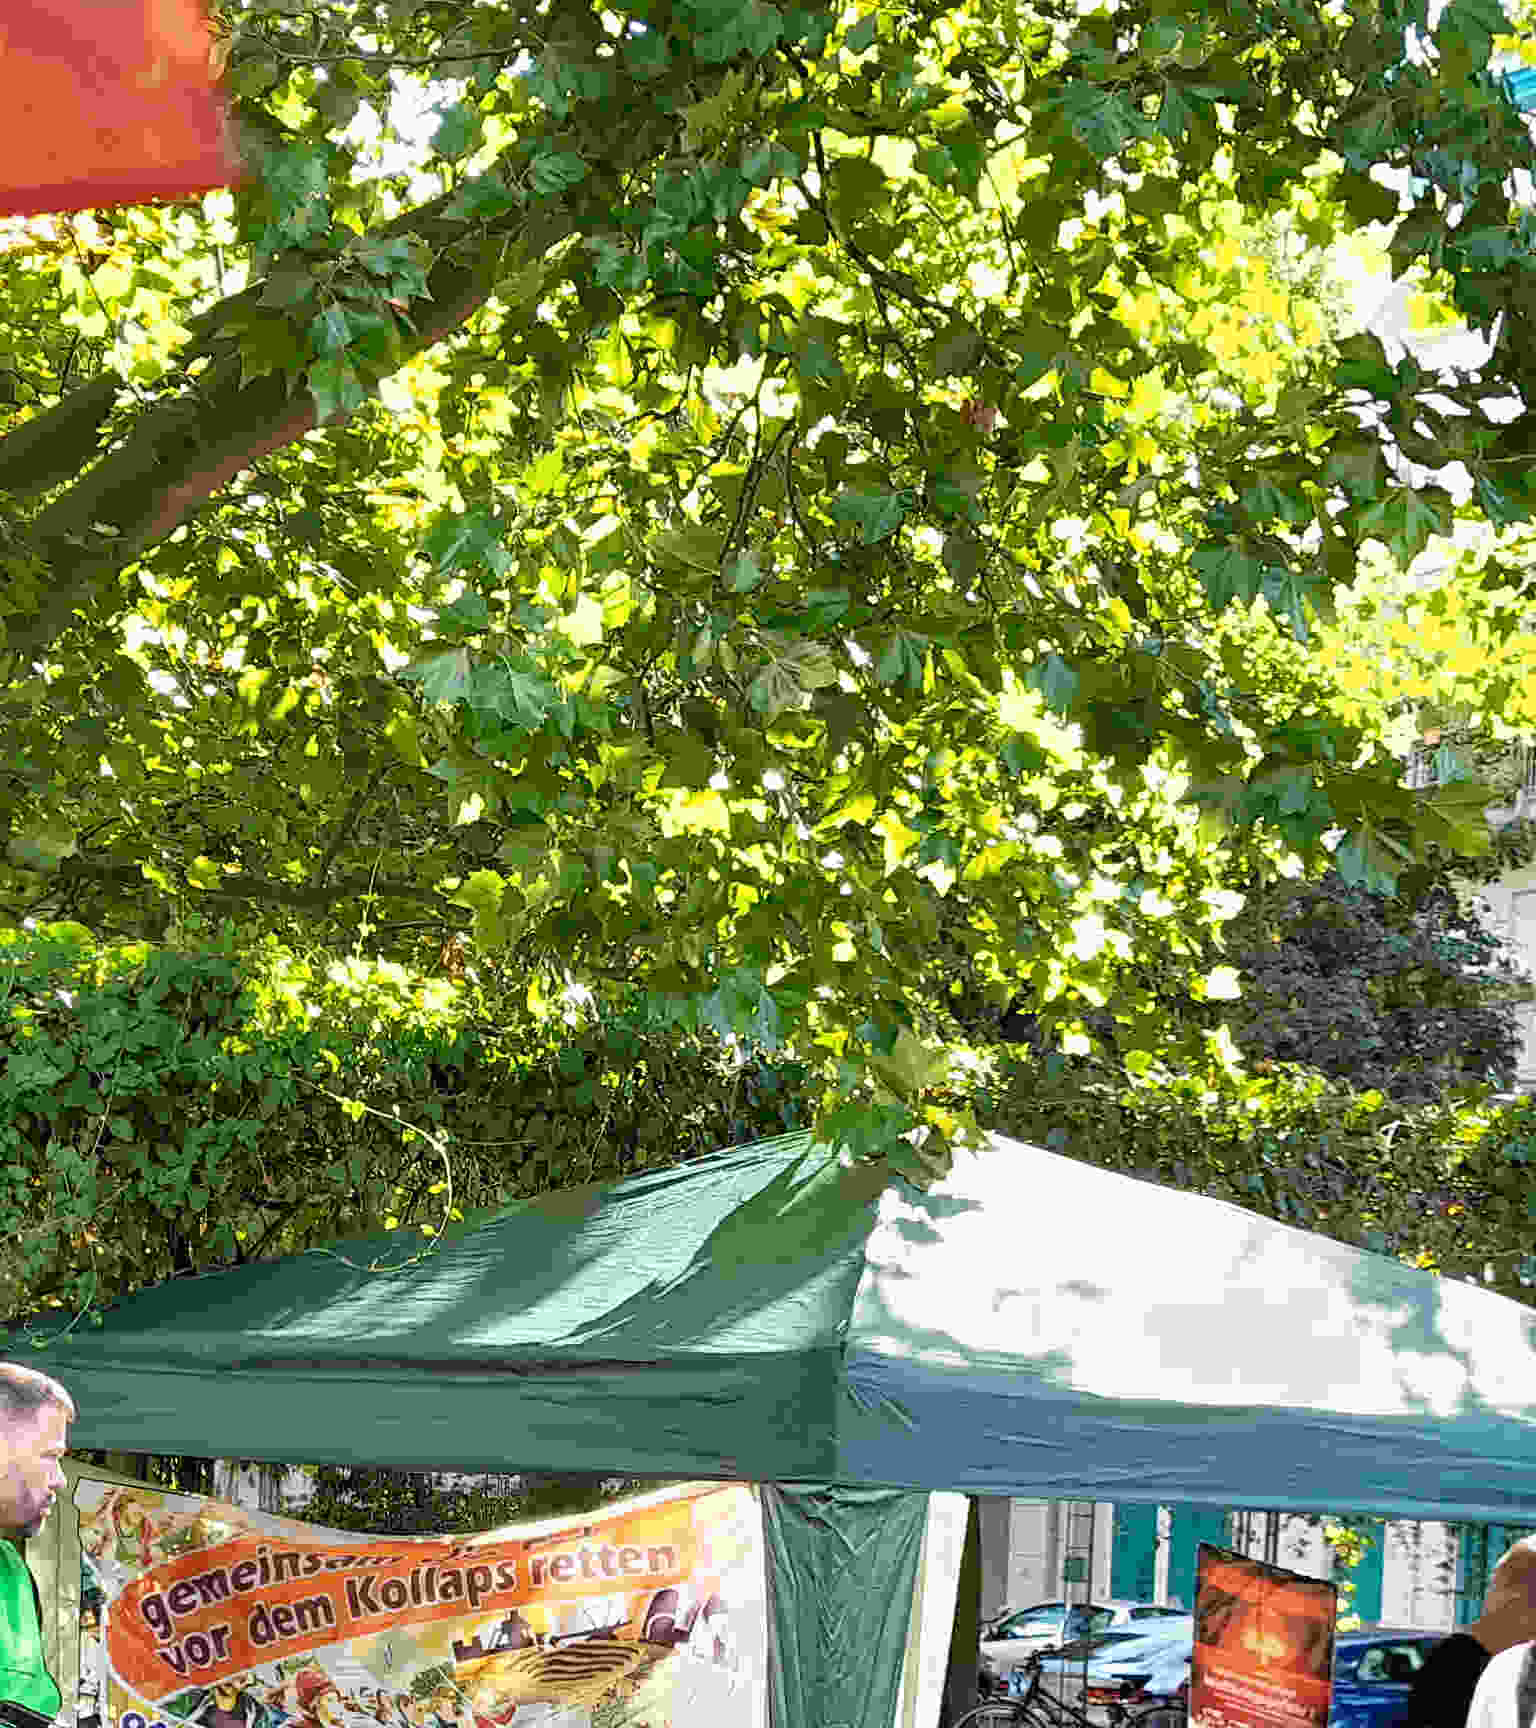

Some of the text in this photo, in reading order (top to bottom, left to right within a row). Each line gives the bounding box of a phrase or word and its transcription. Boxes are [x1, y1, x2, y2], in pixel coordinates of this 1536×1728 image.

[158, 1622, 233, 1675] vor
[247, 1592, 337, 1647] dem
[345, 1561, 517, 1619] Kollaps
[528, 1541, 677, 1586] retten
